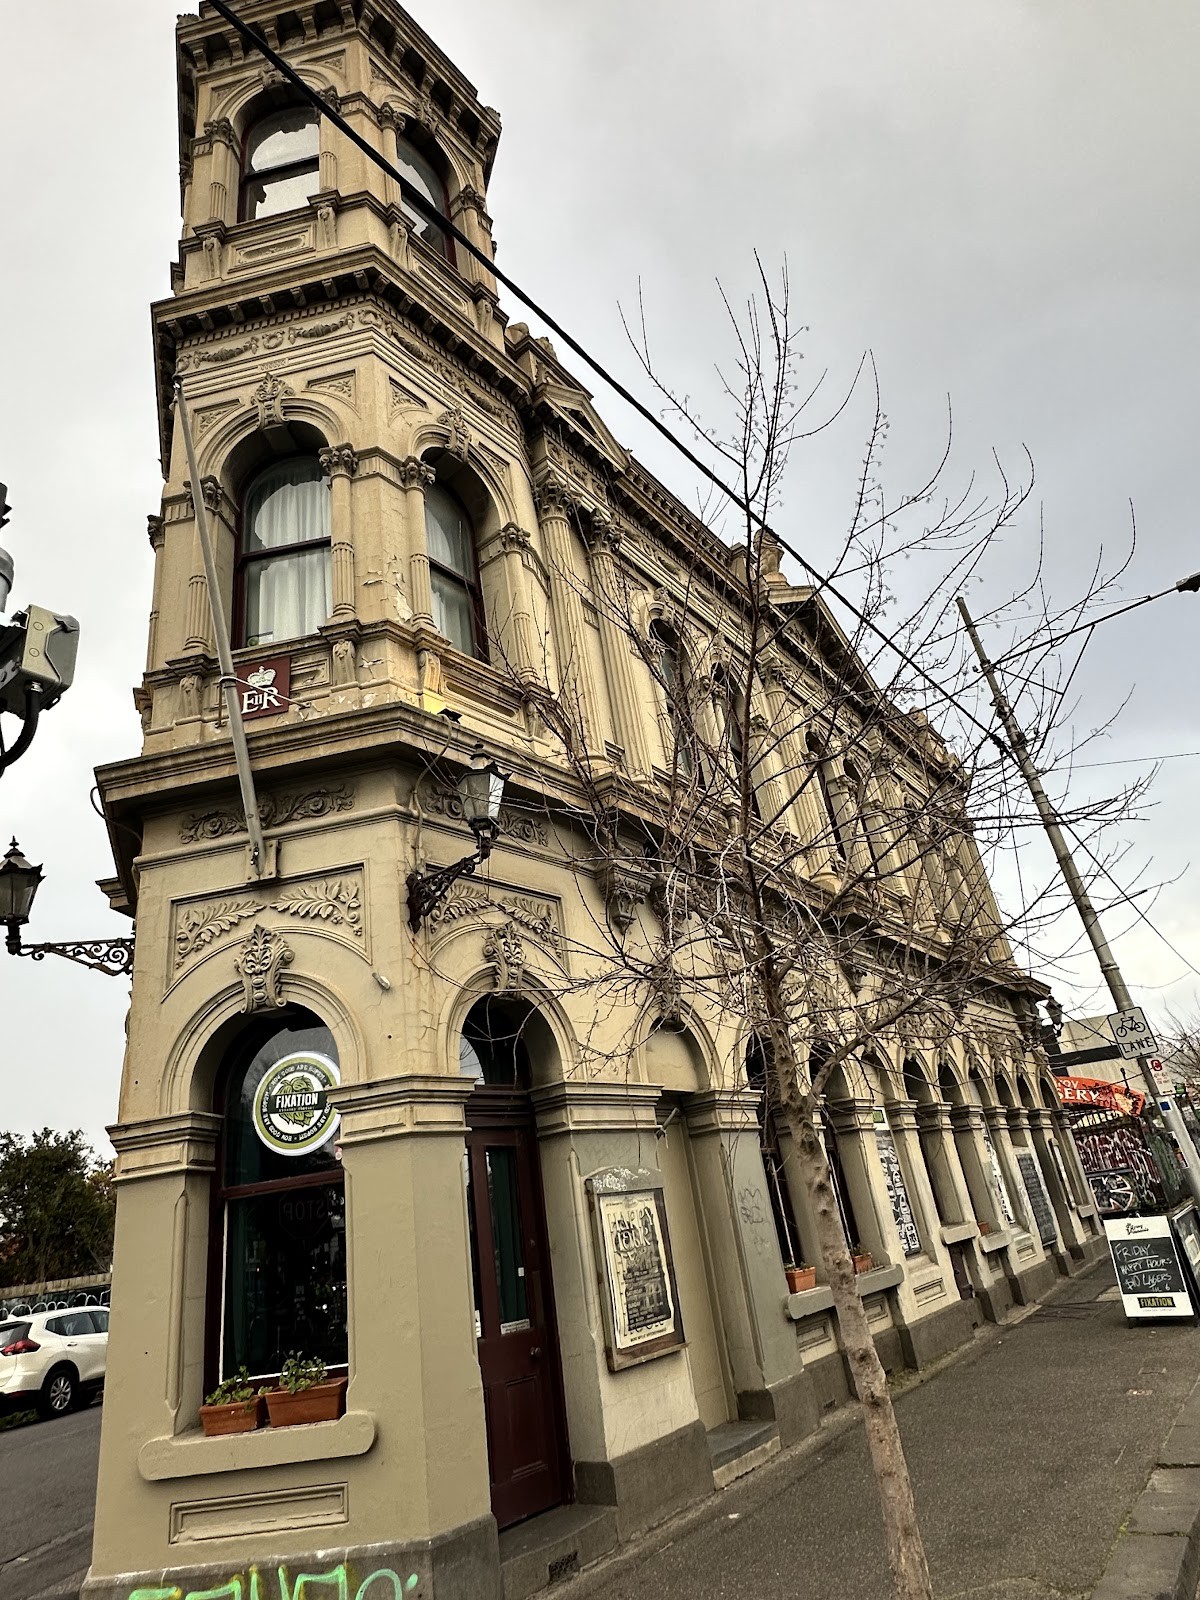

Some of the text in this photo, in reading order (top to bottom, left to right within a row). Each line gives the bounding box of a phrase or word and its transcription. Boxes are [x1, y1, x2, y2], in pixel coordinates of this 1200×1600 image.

[1121, 1037, 1153, 1053] LANE
[275, 1092, 319, 1109] FIXATION
[1115, 1243, 1151, 1261] FRIDAY
[1120, 1258, 1172, 1275] HAPPY HOURS
[1143, 1273, 1172, 1288] LAGERS
[1165, 1283, 1170, 1291] 6
[1140, 1297, 1173, 1308] FIXATION
